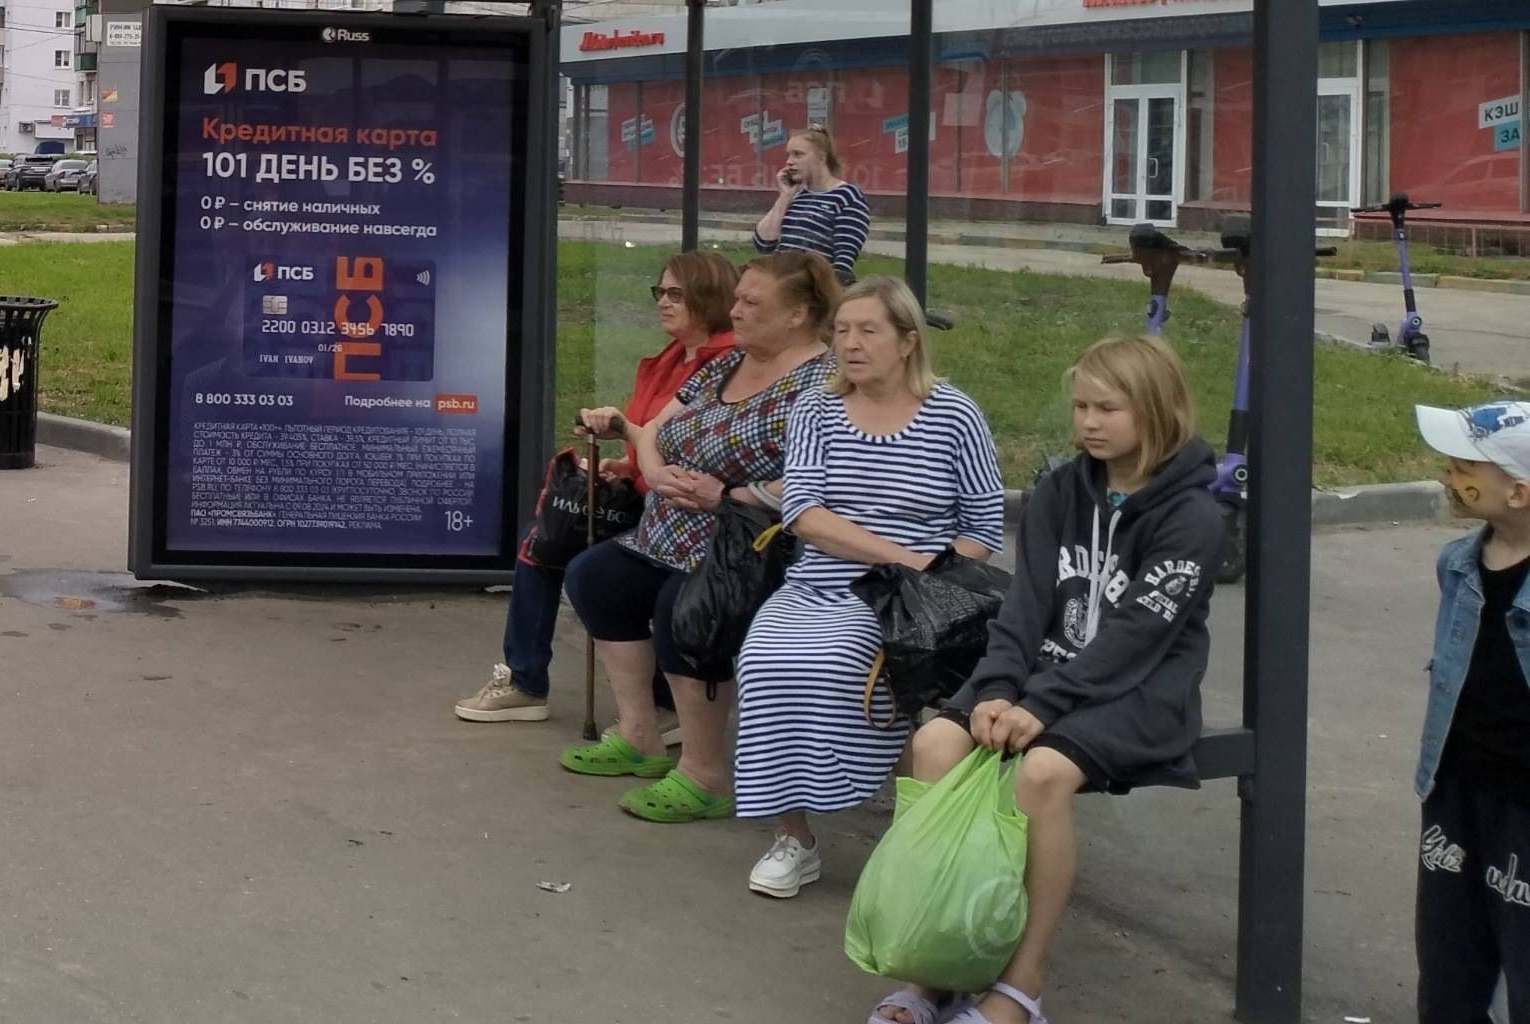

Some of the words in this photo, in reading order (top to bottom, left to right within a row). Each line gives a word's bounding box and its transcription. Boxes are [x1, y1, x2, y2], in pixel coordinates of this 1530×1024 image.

[337, 28, 370, 42] Russ
[244, 68, 308, 93] ПСБ
[202, 116, 349, 146] Кредитная
[356, 127, 437, 150] карта
[202, 151, 247, 178] 101
[255, 153, 339, 184] ДЕНЬ
[347, 157, 403, 183] БЕЗ
[411, 158, 436, 185] %
[200, 195, 212, 210] 0
[214, 196, 226, 210] ₽
[243, 199, 299, 213] снятие
[302, 201, 381, 216] наличных
[199, 216, 211, 230] 0
[213, 216, 225, 231] ₽
[242, 217, 360, 236] обслуживание
[362, 224, 437, 239] навсегда
[277, 265, 314, 281] ПСБ
[261, 319, 296, 335] 2200
[301, 320, 336, 336] 0312
[381, 323, 415, 338] 7890
[333, 255, 384, 383] ПСБ
[259, 354, 279, 364] IVAN
[195, 393, 204, 404] 8
[205, 393, 232, 405] 800
[233, 394, 256, 406] 333
[259, 394, 276, 406] 03
[277, 394, 294, 407] 03
[344, 395, 413, 412] Подробнее
[415, 399, 431, 409] на
[436, 397, 476, 413] psb.ru
[444, 509, 474, 532] 18+
